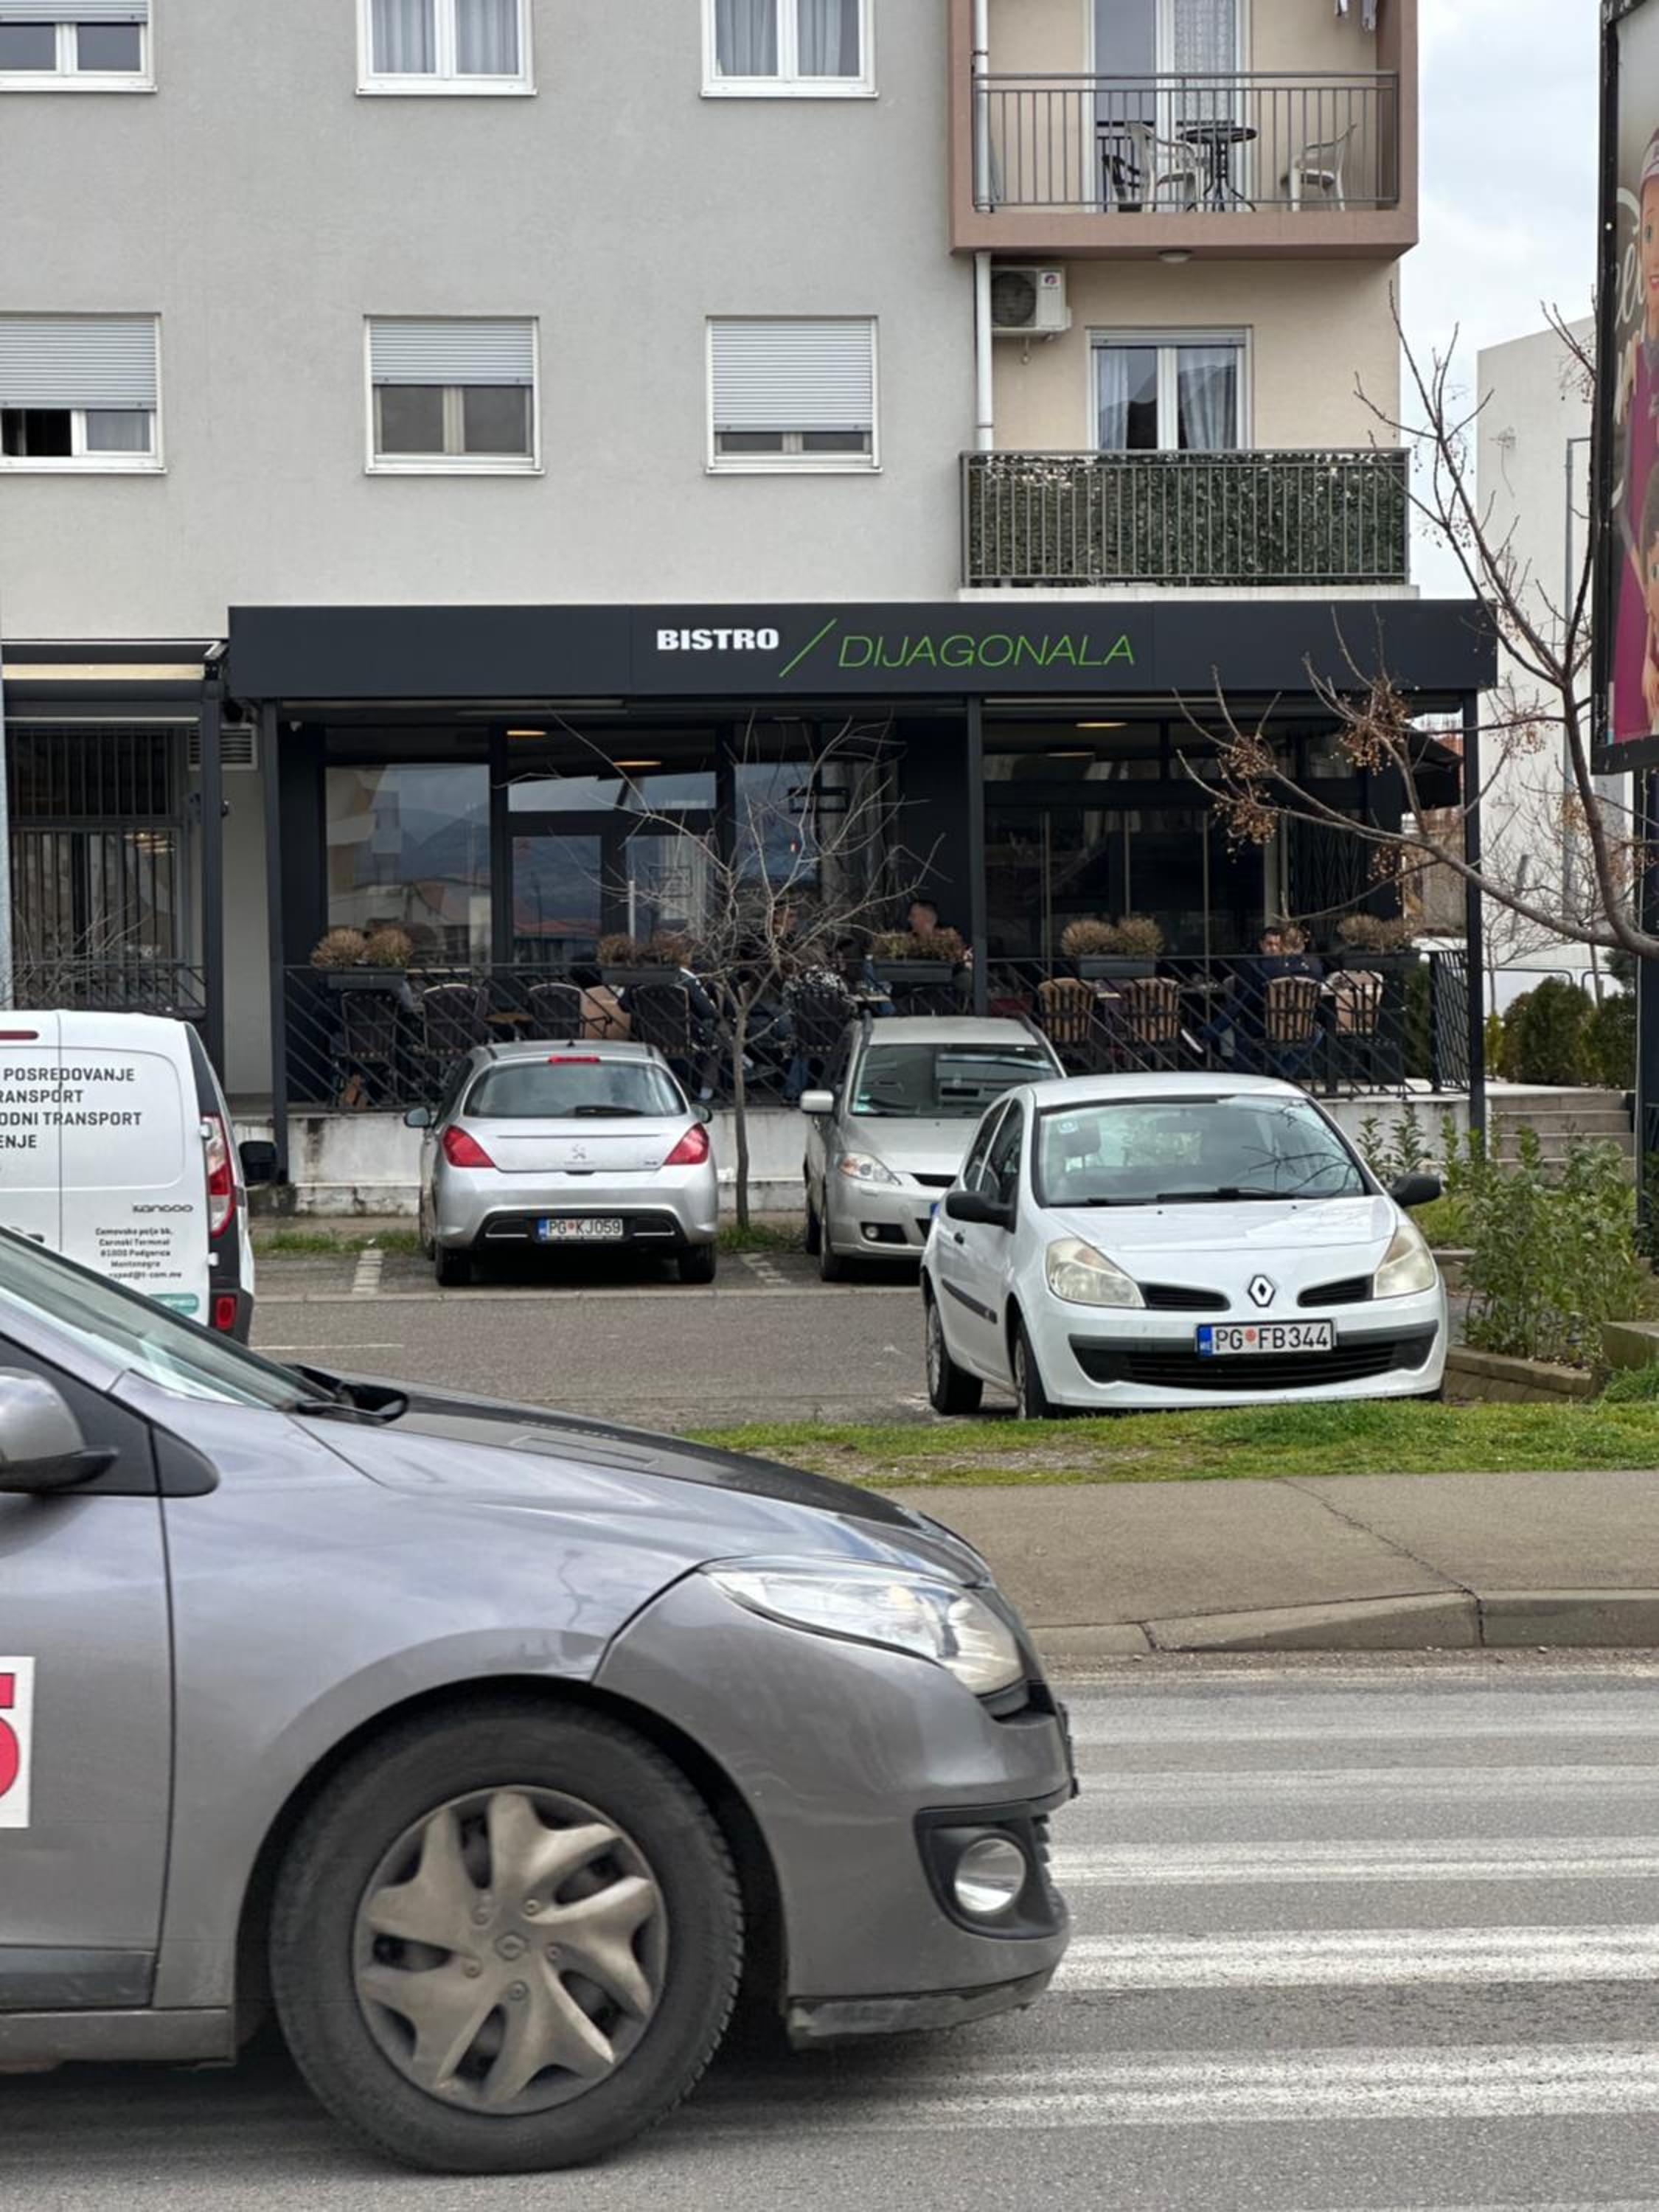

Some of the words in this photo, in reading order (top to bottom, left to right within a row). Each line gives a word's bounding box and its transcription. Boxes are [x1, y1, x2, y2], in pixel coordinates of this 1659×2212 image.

[657, 628, 779, 650] BISTRO
[838, 635, 1134, 667] DIJAGONALA
[4, 1068, 135, 1082] POSREDOVANJE
[43, 1112, 142, 1126] TRANSPORT
[549, 1220, 567, 1234] PG
[1215, 1329, 1243, 1351] PG
[1258, 1326, 1329, 1349] FB344
